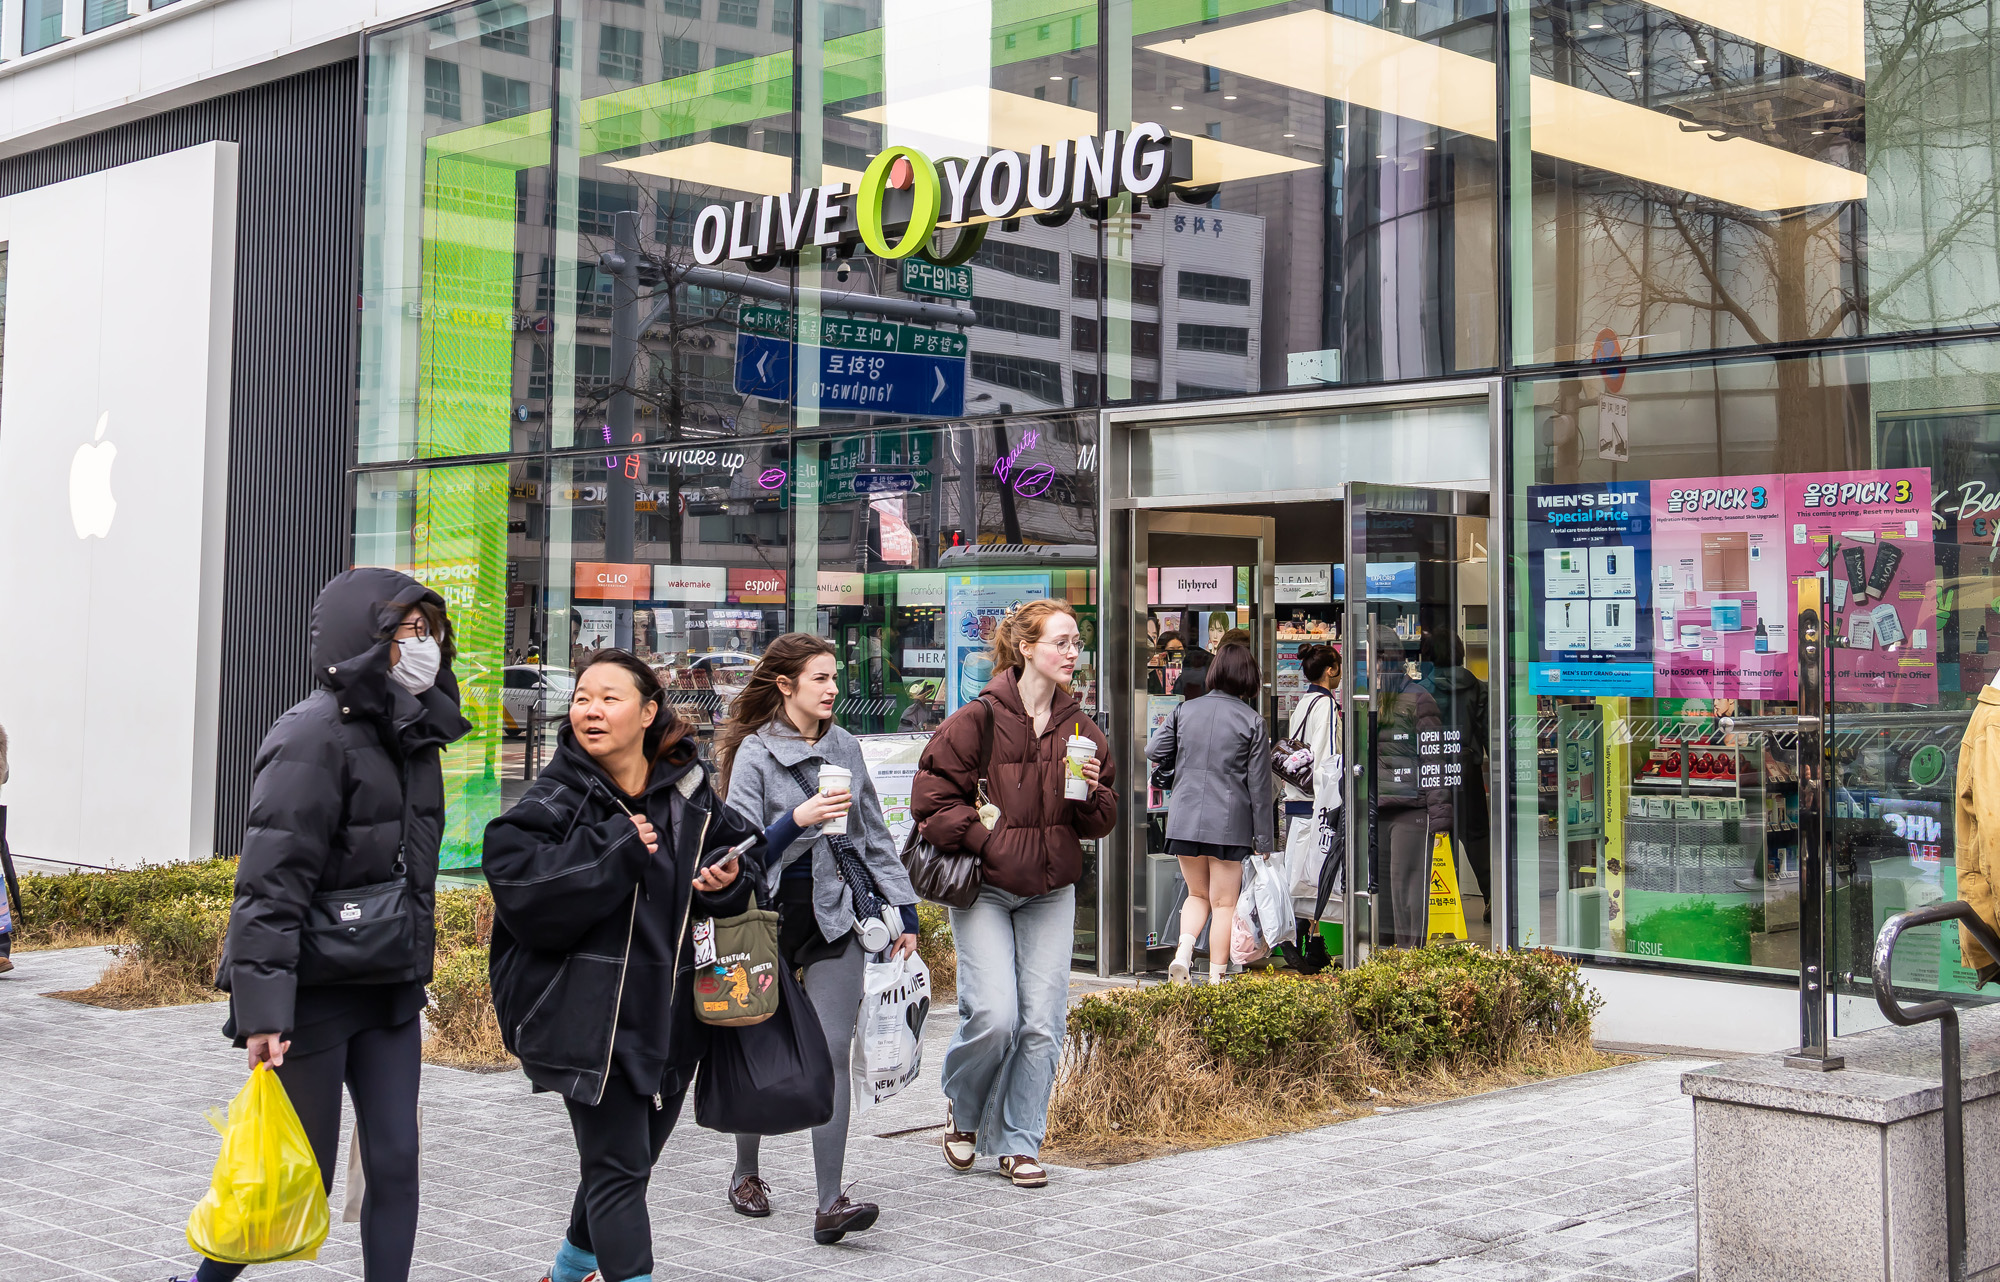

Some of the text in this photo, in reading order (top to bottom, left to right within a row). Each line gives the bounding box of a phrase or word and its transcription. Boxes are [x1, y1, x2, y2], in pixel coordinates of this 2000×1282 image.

[692, 182, 850, 265] OLIVE
[944, 122, 1172, 223] YOUNG
[992, 428, 1040, 484] Beauty
[662, 450, 745, 477] Make up
[1895, 480, 1911, 503] 3
[1537, 492, 1639, 508] MEN'S EDIT
[1751, 486, 1766, 510] 3
[1548, 508, 1629, 526] Special Price
[597, 573, 628, 584] CLIO
[668, 580, 711, 589] wakemake
[1274, 576, 1312, 586] CLEAN
[745, 578, 779, 595] espoir
[817, 584, 839, 592] ANILA
[1178, 579, 1218, 592] lilybyred
[918, 652, 945, 663] HERA
[1659, 669, 1669, 677] Up
[1713, 669, 1741, 677] Limited
[1743, 669, 1762, 677] Time
[1838, 670, 1850, 678] Off
[1854, 670, 1886, 678] Limited
[1909, 671, 1931, 679] Offer
[1421, 731, 1440, 742] OPEN
[1443, 730, 1460, 741] 10:00
[1421, 743, 1461, 755] CLOSE 23:00
[1421, 764, 1440, 775] OPEN
[1444, 763, 1461, 774] 10:00
[1421, 777, 1440, 787] CLOSE
[1444, 776, 1461, 786] 23:00
[1637, 941, 1663, 956] ISSUE
[750, 962, 773, 974] LORETTA
[875, 1078, 896, 1090] NEW
